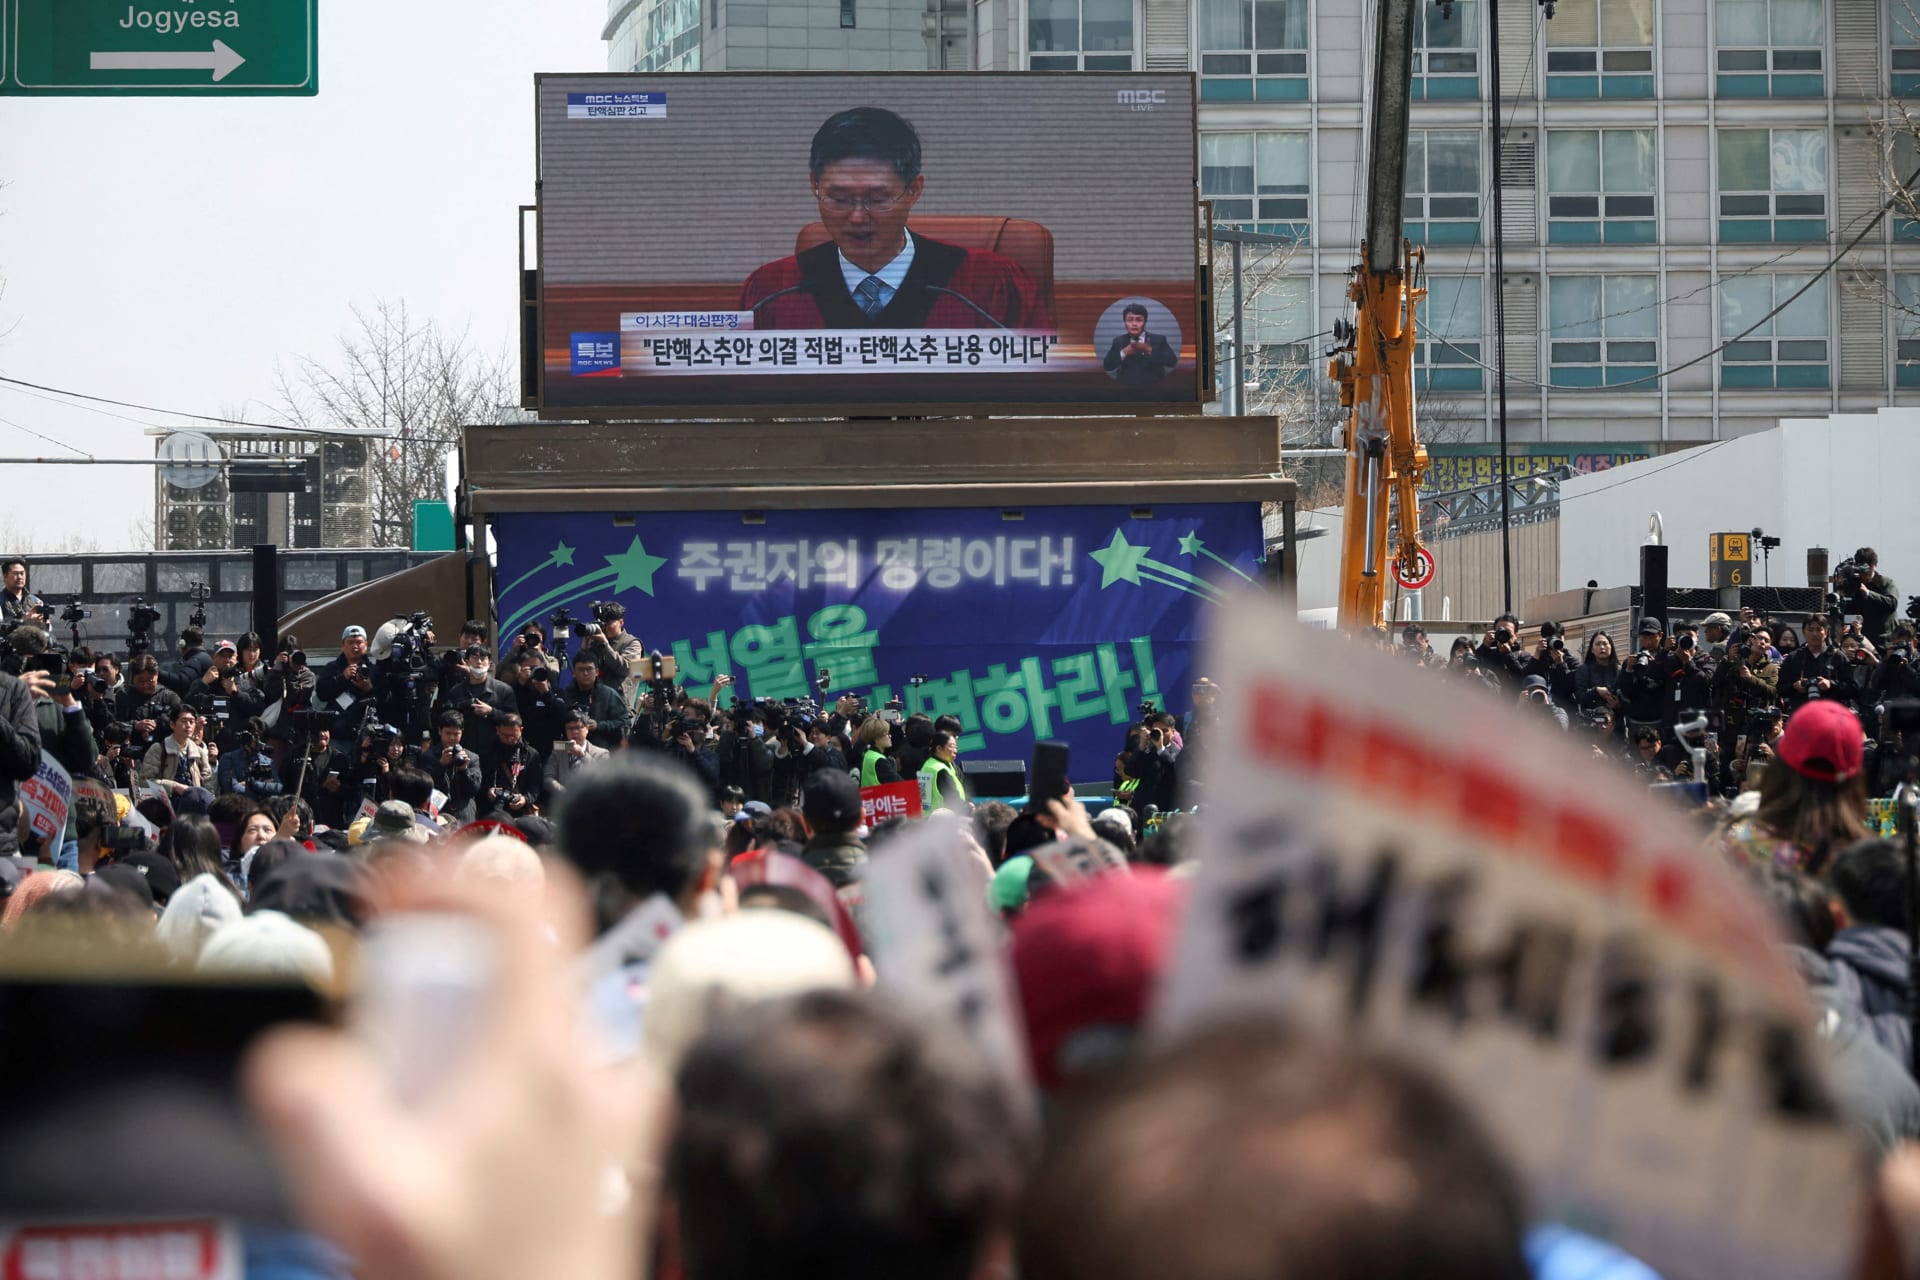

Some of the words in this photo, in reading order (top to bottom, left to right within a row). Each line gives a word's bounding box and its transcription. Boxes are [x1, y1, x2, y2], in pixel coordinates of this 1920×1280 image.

[119, 6, 240, 33] Jogyesa
[587, 106, 625, 116] 탄핵심판
[628, 106, 648, 116] 선고
[635, 315, 649, 328] 이
[652, 314, 681, 328] 시각
[684, 313, 738, 328] 대심판정
[577, 342, 613, 358] 특보
[643, 336, 754, 367] "탄핵소추안
[759, 337, 798, 366] 의결
[945, 334, 984, 366] 남용
[988, 335, 1058, 364] 아니다"
[677, 539, 857, 592] 주권자의
[876, 536, 1074, 589] 명령이다!
[1731, 568, 1741, 584] 6
[638, 604, 880, 710] 석열을
[825, 635, 1166, 754] 면하라!
[861, 795, 907, 816] 봄에는
